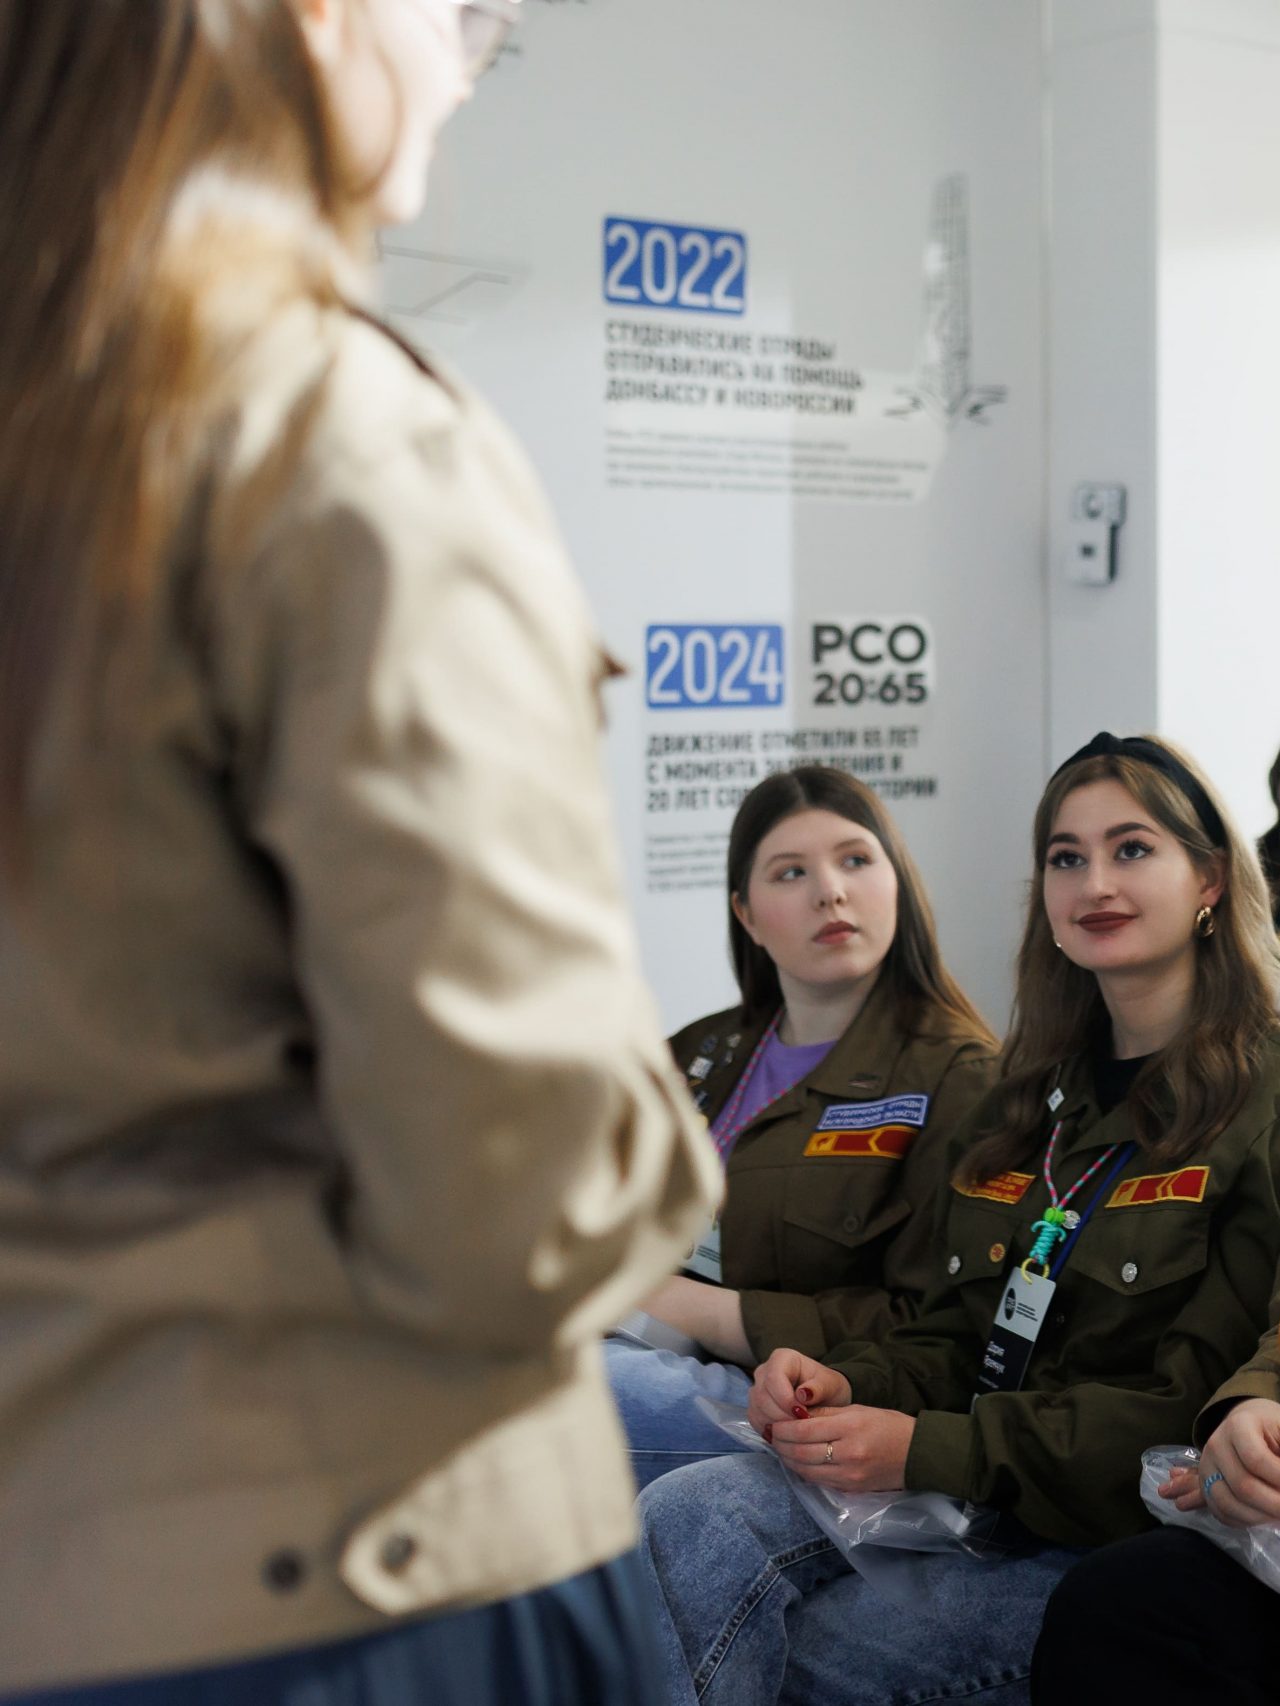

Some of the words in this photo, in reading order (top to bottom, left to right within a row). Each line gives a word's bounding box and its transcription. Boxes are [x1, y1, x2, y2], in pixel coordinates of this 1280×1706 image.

[606, 222, 743, 312] 2022
[649, 629, 783, 704] 2024
[811, 622, 927, 666] РСО
